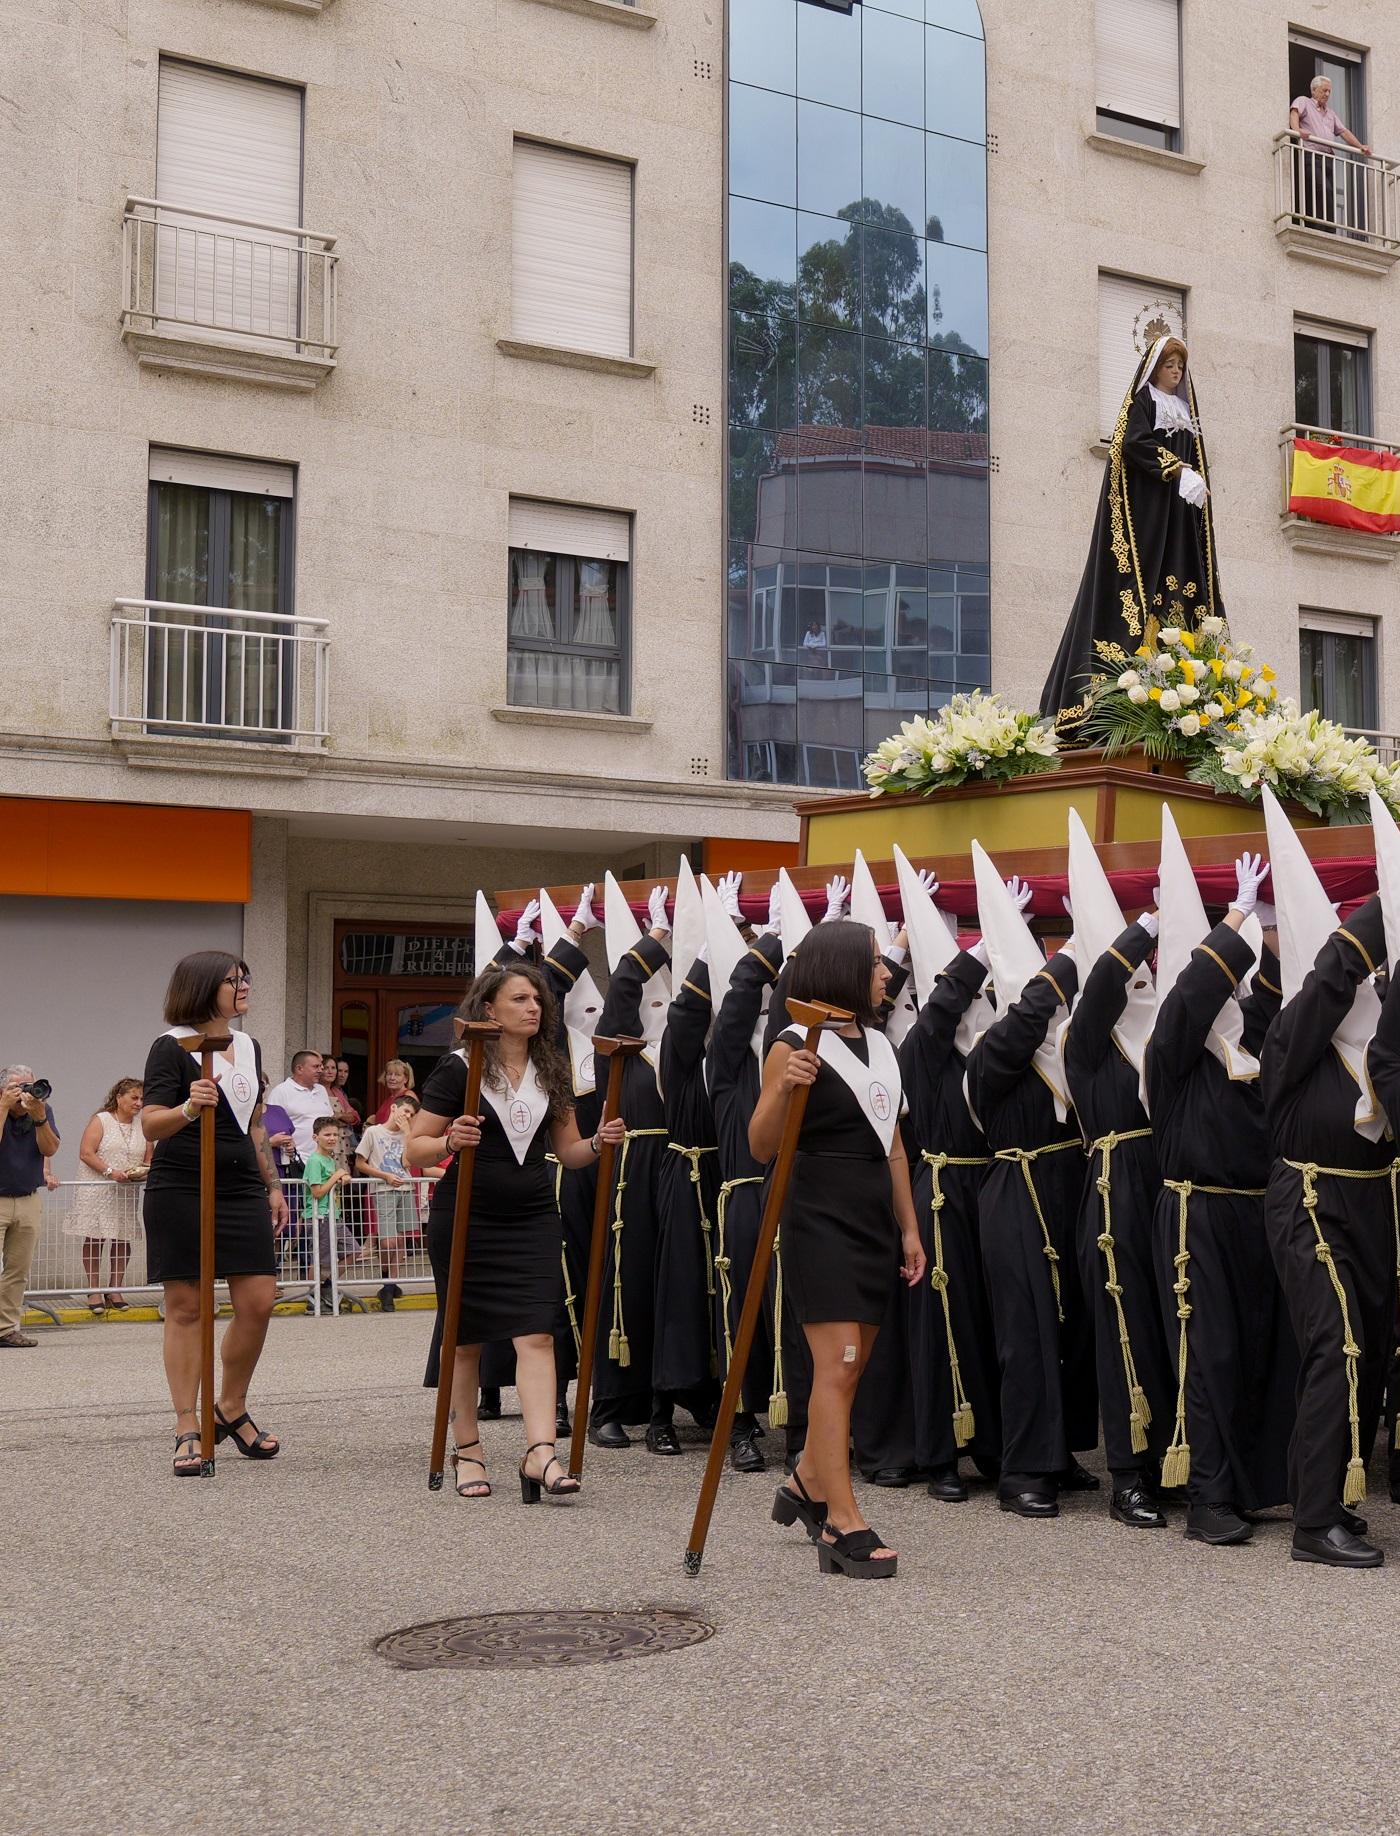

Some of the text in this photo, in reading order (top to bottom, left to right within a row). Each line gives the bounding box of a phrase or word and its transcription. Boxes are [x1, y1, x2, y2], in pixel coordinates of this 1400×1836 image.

[408, 938, 471, 954] DIFICI
[433, 950, 444, 961] 4
[395, 960, 474, 974] CRUCEIR
